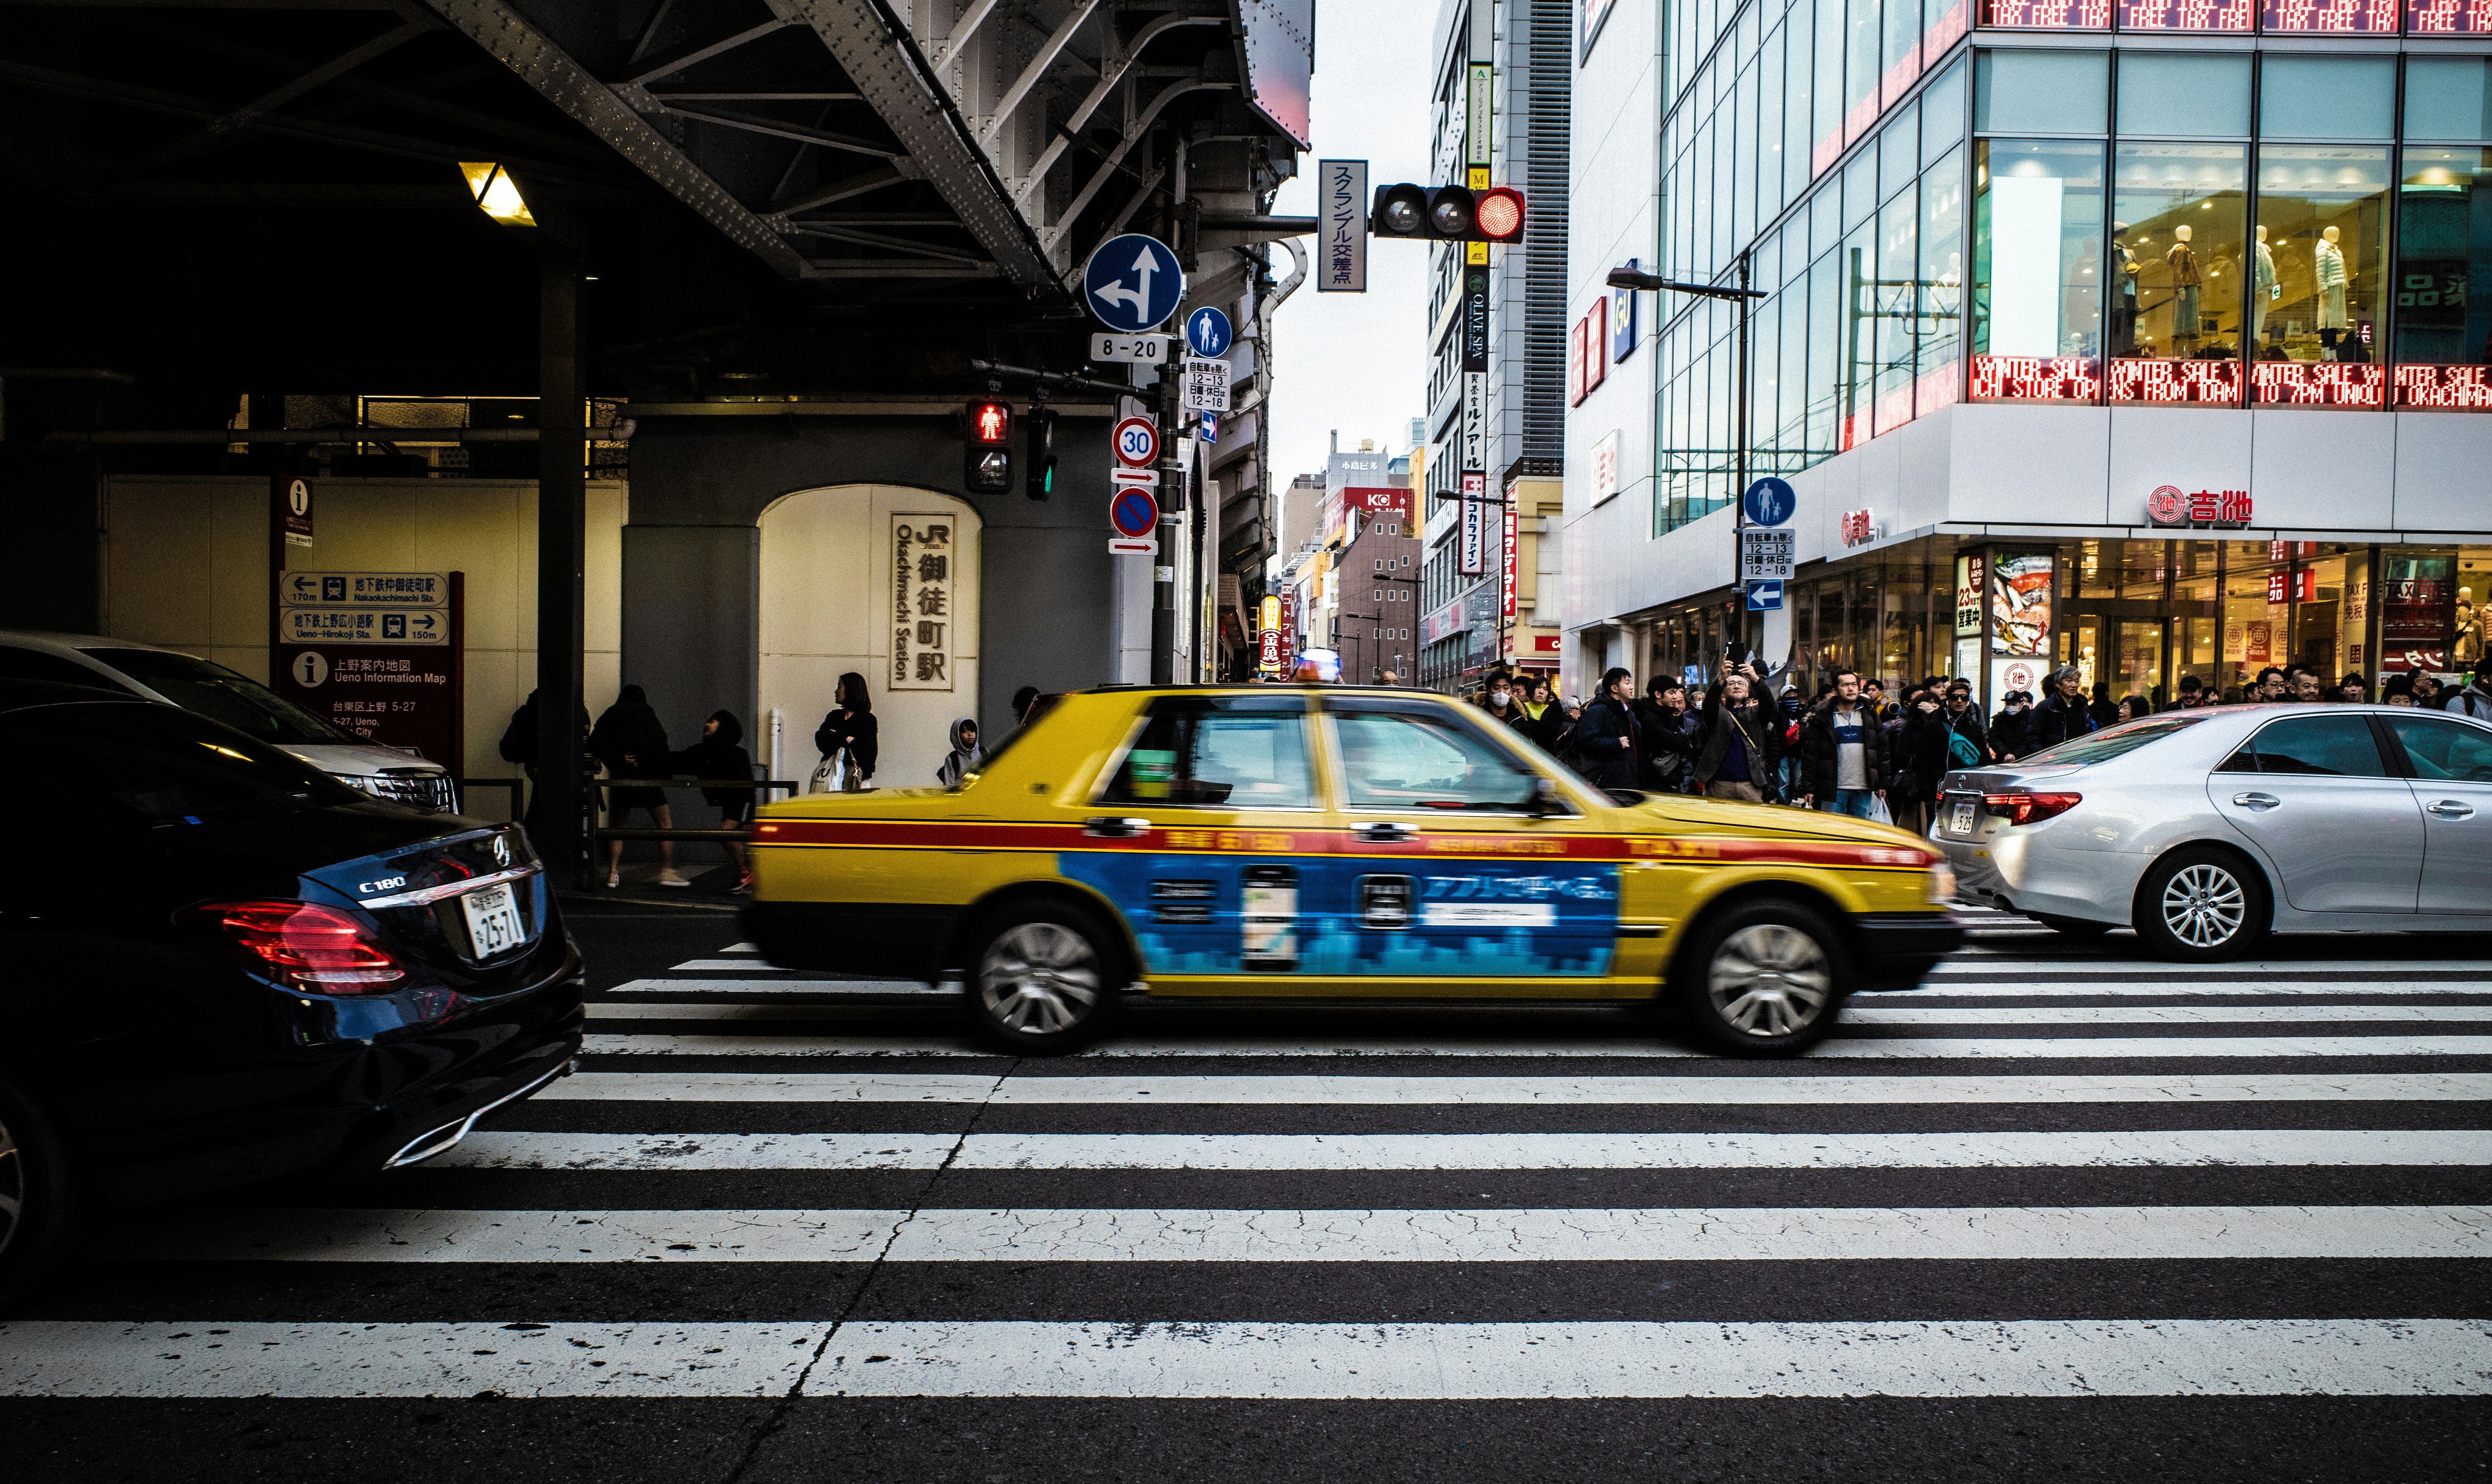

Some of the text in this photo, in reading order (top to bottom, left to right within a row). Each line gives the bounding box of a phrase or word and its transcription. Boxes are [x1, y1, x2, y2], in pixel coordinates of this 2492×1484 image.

[1990, 4, 2022, 25] TAX
[2032, 5, 2068, 25] FREE
[2130, 7, 2166, 27] FREE
[2177, 7, 2209, 28] TAX
[2276, 9, 2308, 29] TAX
[2319, 10, 2355, 30] FREE
[2418, 10, 2456, 31] FREE
[1332, 167, 1354, 284] スクランブル交差点
[1616, 288, 1631, 335] GU
[1472, 294, 1484, 358] OLIVE SPA
[1588, 311, 1599, 346] UNI
[1573, 331, 1583, 364] ユニ
[1190, 362, 1227, 374] 自転車を除く
[1588, 344, 1599, 383] QLO
[1193, 373, 1223, 385] 12-13
[1976, 358, 2041, 379] WINTER
[2050, 359, 2089, 380] SALE
[2181, 363, 2221, 383] SALE
[2313, 365, 2352, 385] SALE
[2446, 367, 2486, 387] SALE
[1572, 363, 1583, 396] クロ
[2012, 378, 2064, 398] STORE
[2144, 382, 2187, 400] FROM
[2198, 382, 2237, 402] 10AM
[2260, 383, 2279, 403] TO
[2291, 383, 2324, 403] 7PM
[1193, 395, 1222, 407] 12-18
[1123, 431, 1149, 454] 30
[1342, 461, 1378, 470] 小島ビル
[2190, 489, 2252, 522] 吉池
[916, 525, 949, 544] JR
[1746, 532, 1792, 542] 自転車を除く
[1751, 544, 1786, 553] 12-13
[1750, 565, 1786, 575] 12-18
[355, 578, 435, 593] 地下鉄仲御徒町駅
[2270, 576, 2282, 588] ユニ
[2269, 589, 2282, 601] クロ
[2346, 584, 2360, 596] TAX
[292, 593, 316, 601] 170m
[354, 594, 435, 602] Nakaokachimachi Sta.
[895, 524, 912, 680] Okachimachi Station
[294, 614, 374, 628] 地下鉄上野広小路駅
[916, 554, 947, 681] 御徒町駅
[1959, 608, 1979, 628] 営業中
[296, 630, 371, 639] Ueno-Hirokoji Sta.
[412, 631, 436, 639] 150m
[1263, 633, 1278, 660] 金魚
[335, 660, 410, 672] 上野案内地図
[335, 672, 446, 684] Ueno Information Map
[333, 702, 416, 712] 台東区上野 5-27
[333, 717, 379, 726] 5-27, Ueno,
[356, 728, 372, 737] City
